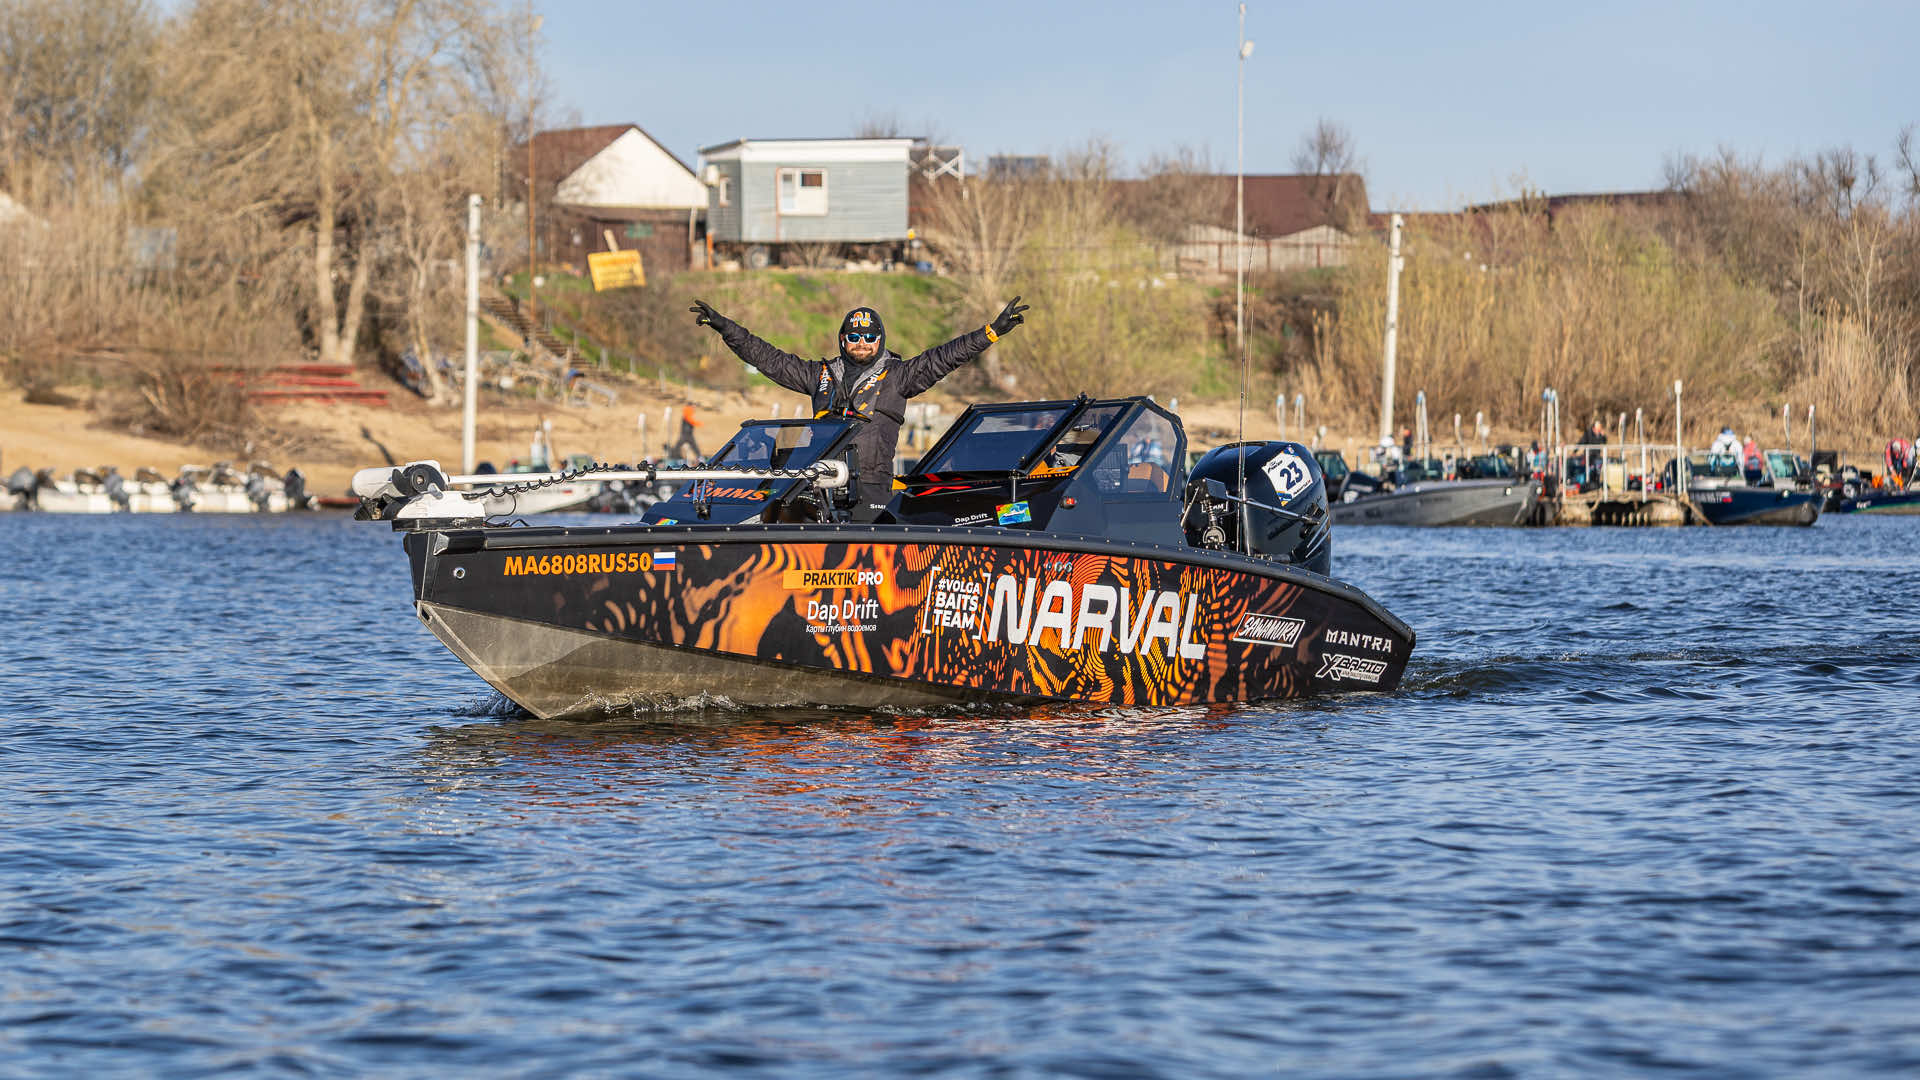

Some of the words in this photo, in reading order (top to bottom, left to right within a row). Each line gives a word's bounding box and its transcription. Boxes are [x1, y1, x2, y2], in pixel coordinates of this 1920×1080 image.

[1280, 461, 1303, 490] 23
[970, 512, 988, 521] Drift
[504, 552, 651, 576] MA6808RUS50
[938, 577, 980, 595] #VOLGA
[807, 600, 839, 625] Dap
[842, 597, 879, 620] Drift
[935, 591, 979, 612] BAITS
[934, 608, 976, 630] TEAM
[987, 574, 1206, 660] NARVAL
[1238, 616, 1301, 643] SAWAMURA
[1325, 628, 1393, 653] MANTRA
